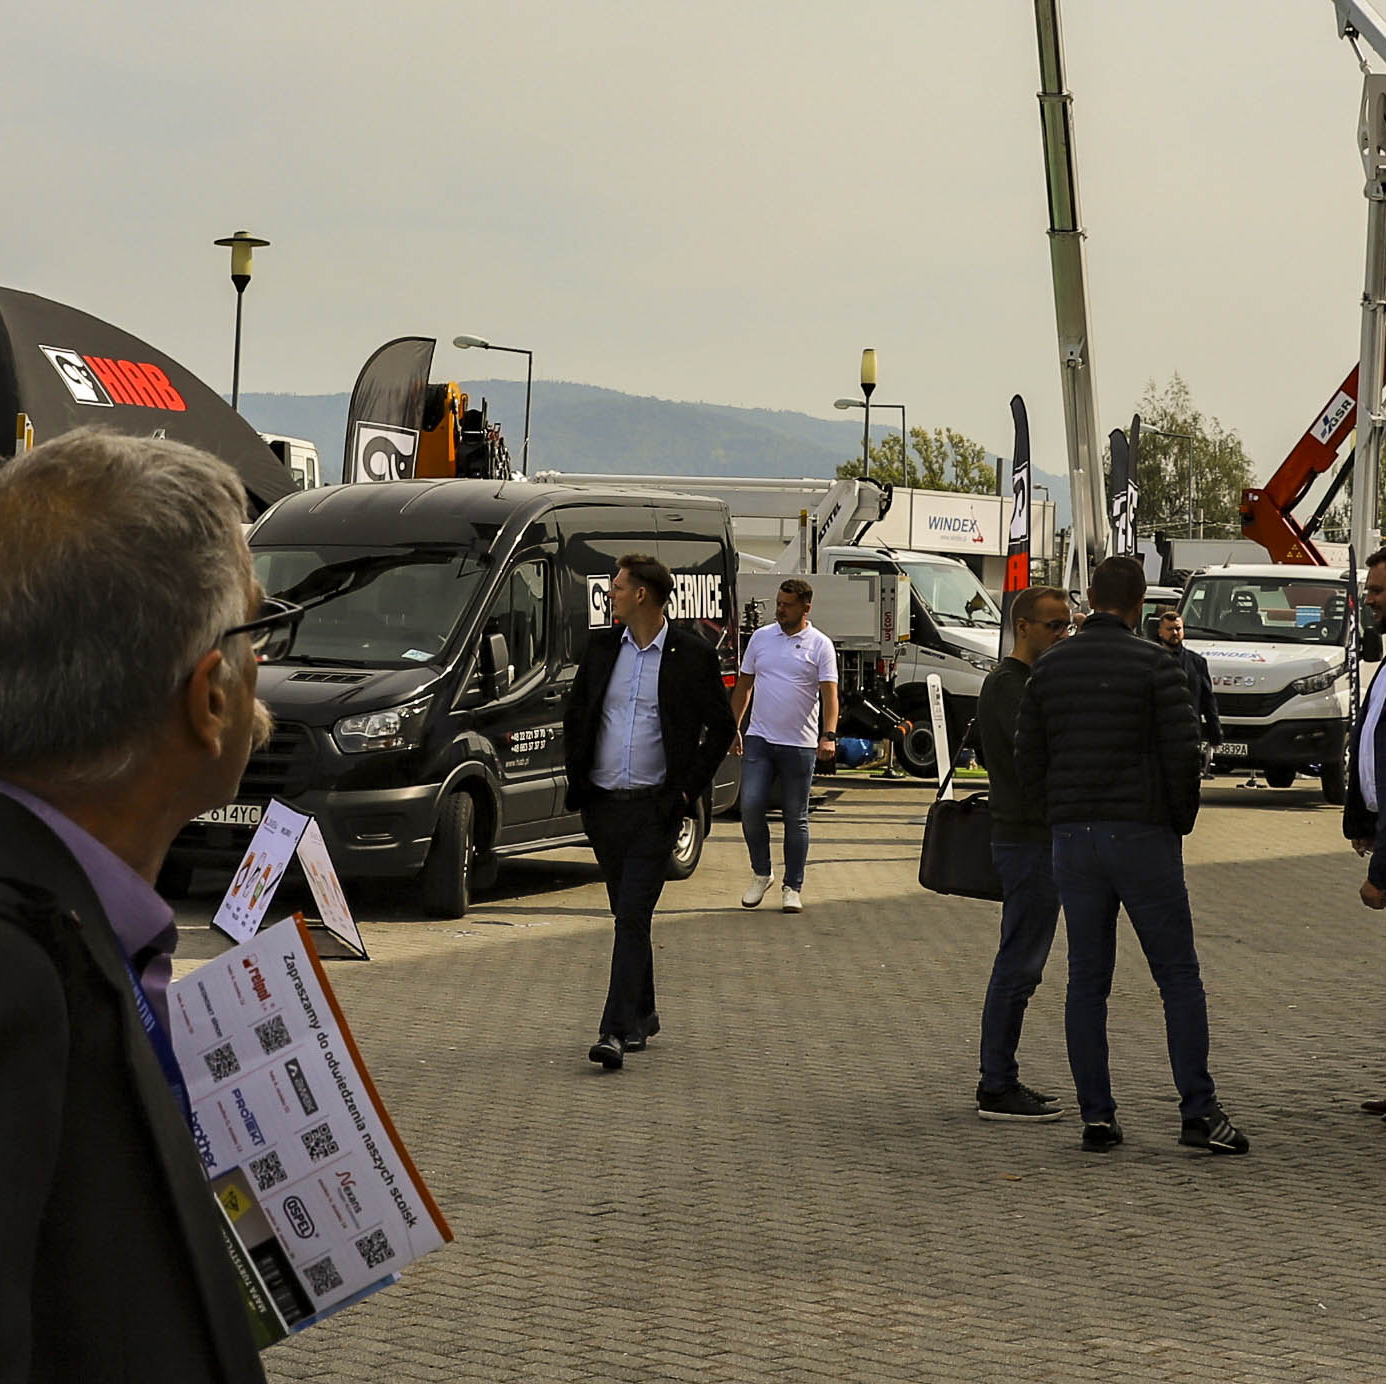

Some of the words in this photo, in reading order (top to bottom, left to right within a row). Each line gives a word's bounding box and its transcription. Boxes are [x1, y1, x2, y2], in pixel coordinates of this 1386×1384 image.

[82, 354, 188, 412] HIAB
[1330, 399, 1352, 427] GSR
[928, 515, 977, 534] WINDEX
[667, 573, 723, 620] SERVICE
[1212, 675, 1254, 687] VECO
[248, 967, 272, 1002] relpol
[283, 951, 322, 1031] Zapraszamy
[316, 1031, 330, 1050] do
[324, 1050, 366, 1132] odwiedzenia
[362, 1132, 396, 1186] naszych
[389, 1186, 418, 1229] stoisk
[190, 1110, 218, 1169] brother
[231, 1087, 266, 1147] PROTEKT
[335, 1170, 363, 1215] Nexans
[285, 1198, 311, 1236] OSPEL
